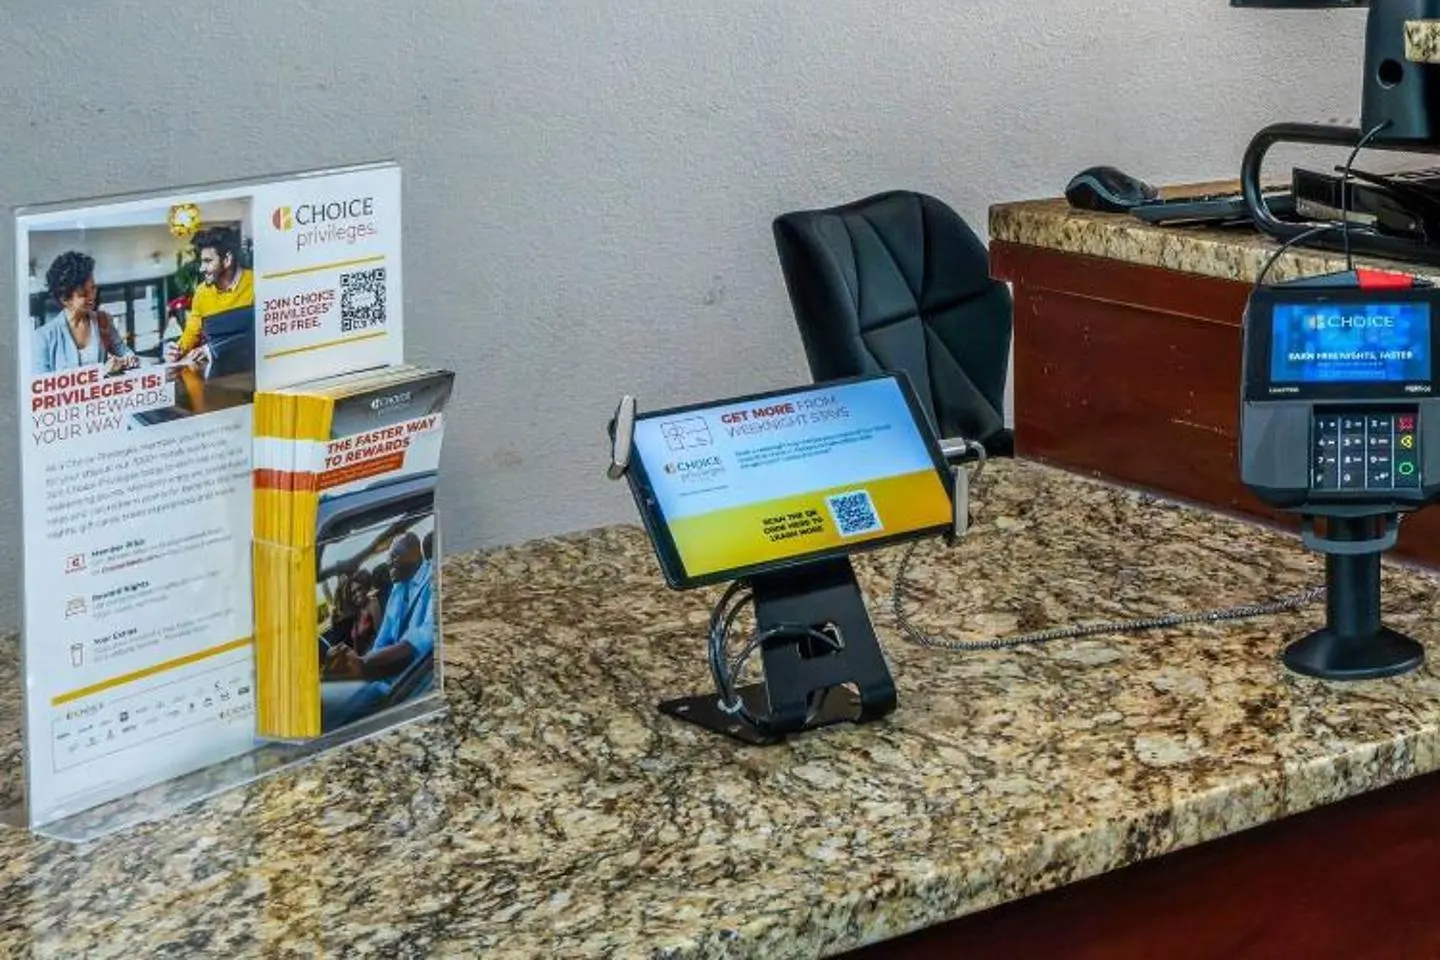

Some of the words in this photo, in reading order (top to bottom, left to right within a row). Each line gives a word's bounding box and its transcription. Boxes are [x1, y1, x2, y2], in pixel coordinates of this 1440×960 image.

[295, 197, 373, 226] CHOICE
[296, 222, 378, 252] privileges
[263, 297, 290, 311] JOIN
[292, 289, 335, 306] CHOICE
[263, 321, 287, 336] FOR
[1327, 315, 1395, 328] CHOICE
[1379, 348, 1413, 360] FASTER
[31, 369, 99, 394] CHOICE
[141, 375, 161, 390] IS:
[31, 405, 80, 428] YOUR
[721, 410, 748, 424] GET
[752, 403, 795, 419] MORE
[32, 423, 81, 446] YOUR
[328, 439, 352, 455] THE
[355, 426, 404, 447] FASTER
[406, 416, 437, 433] WAY
[324, 454, 342, 468] TO
[345, 436, 411, 463] REWARDS
[677, 456, 721, 471] CHOICE
